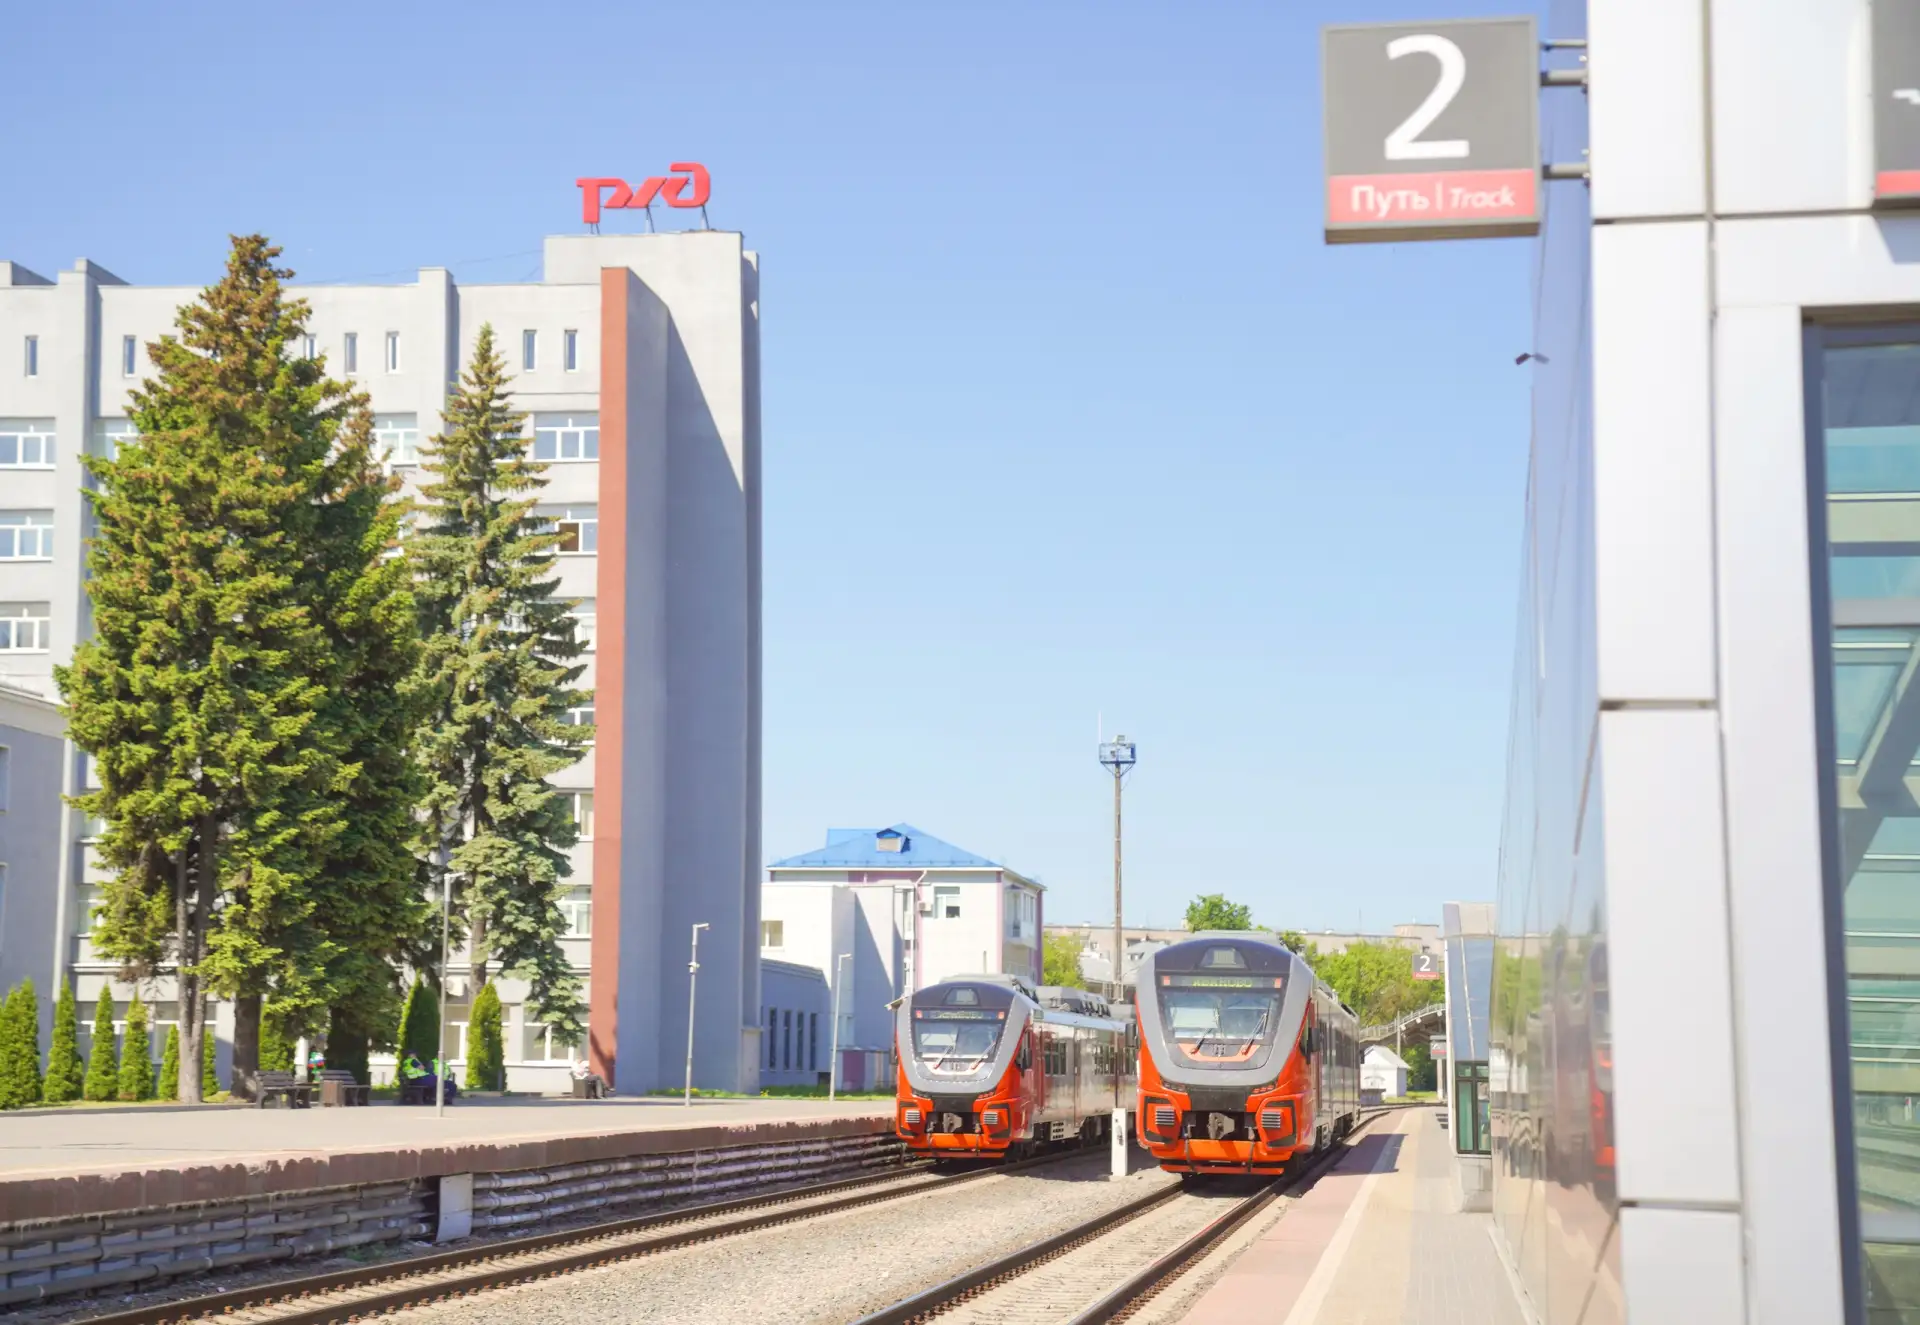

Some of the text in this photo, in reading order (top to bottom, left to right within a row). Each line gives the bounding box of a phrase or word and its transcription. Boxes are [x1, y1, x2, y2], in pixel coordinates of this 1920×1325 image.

[1384, 34, 1470, 160] 2
[1351, 184, 1517, 219] Путь Track
[1419, 955, 1431, 972] 2
